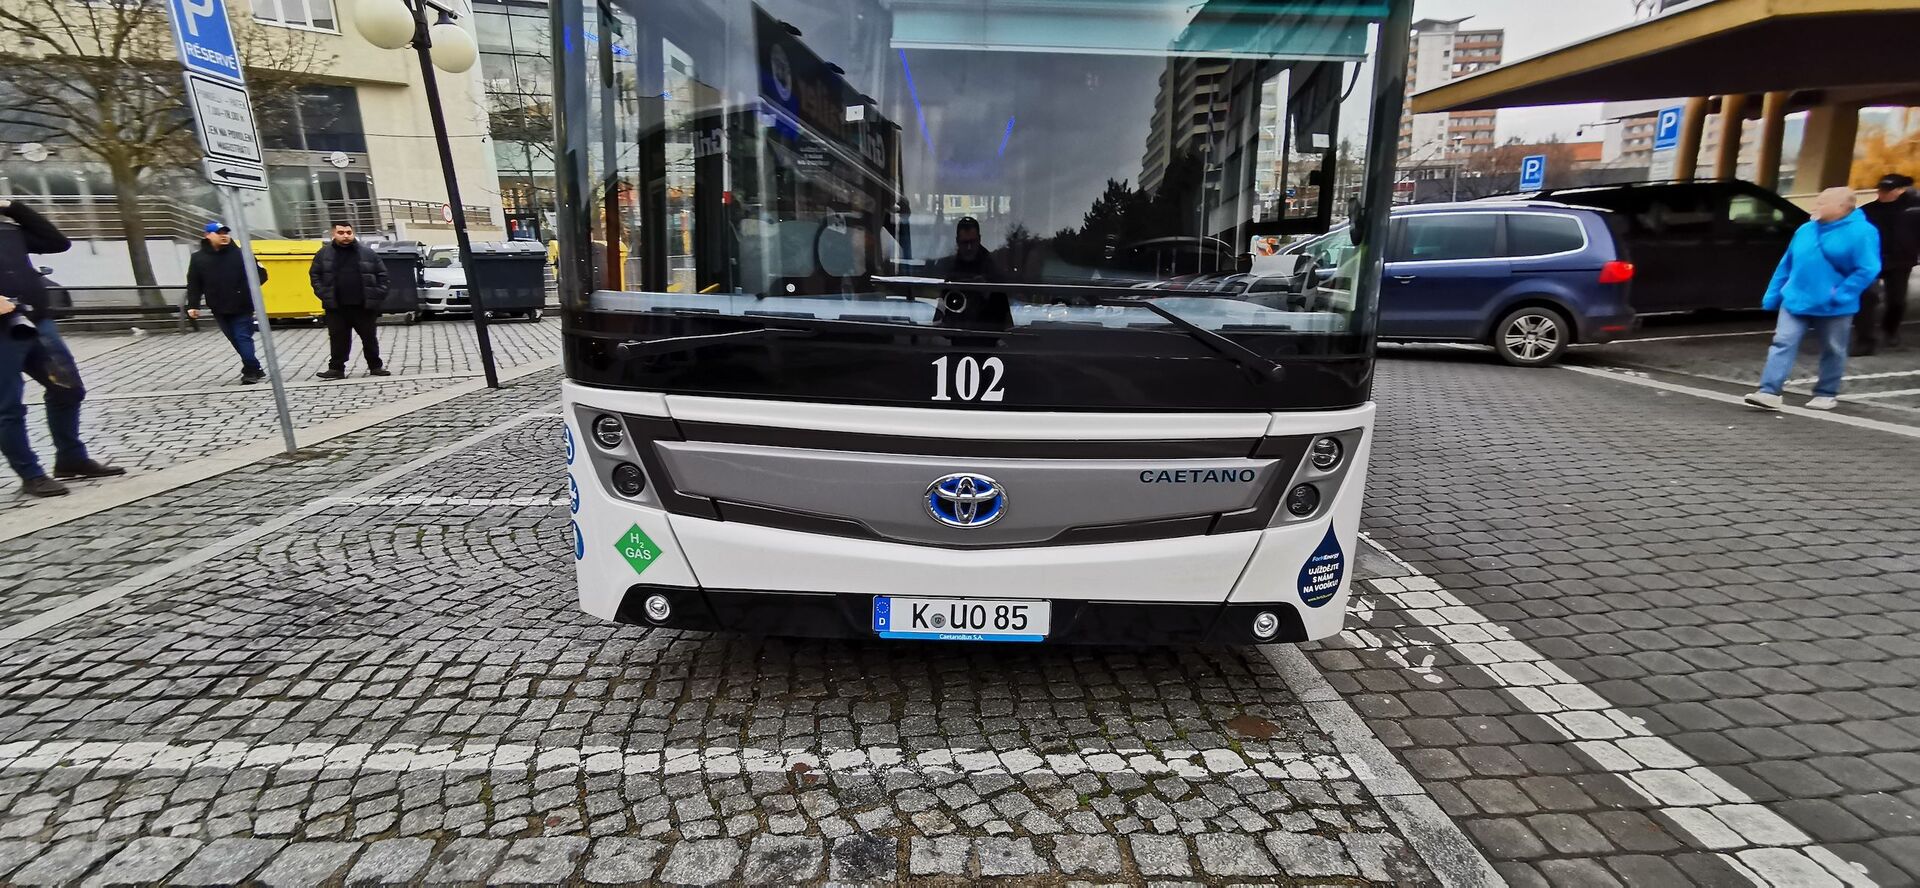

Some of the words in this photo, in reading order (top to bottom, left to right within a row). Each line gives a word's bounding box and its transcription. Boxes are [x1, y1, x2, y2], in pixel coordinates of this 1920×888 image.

[182, 0, 214, 36] P
[185, 41, 238, 70] RÉSERVÉ
[1660, 111, 1678, 138] P
[1525, 159, 1540, 180] P
[931, 355, 1005, 402] 102
[1139, 469, 1256, 483] CAETANO
[625, 547, 652, 560] GAS
[1308, 563, 1340, 576] UJÍŽDĚJTE
[1318, 572, 1334, 583] NÁMI
[1303, 586, 1314, 594] NA
[879, 617, 886, 626] D
[912, 603, 930, 629] K
[950, 603, 987, 630] UO
[993, 605, 1028, 631] 85
